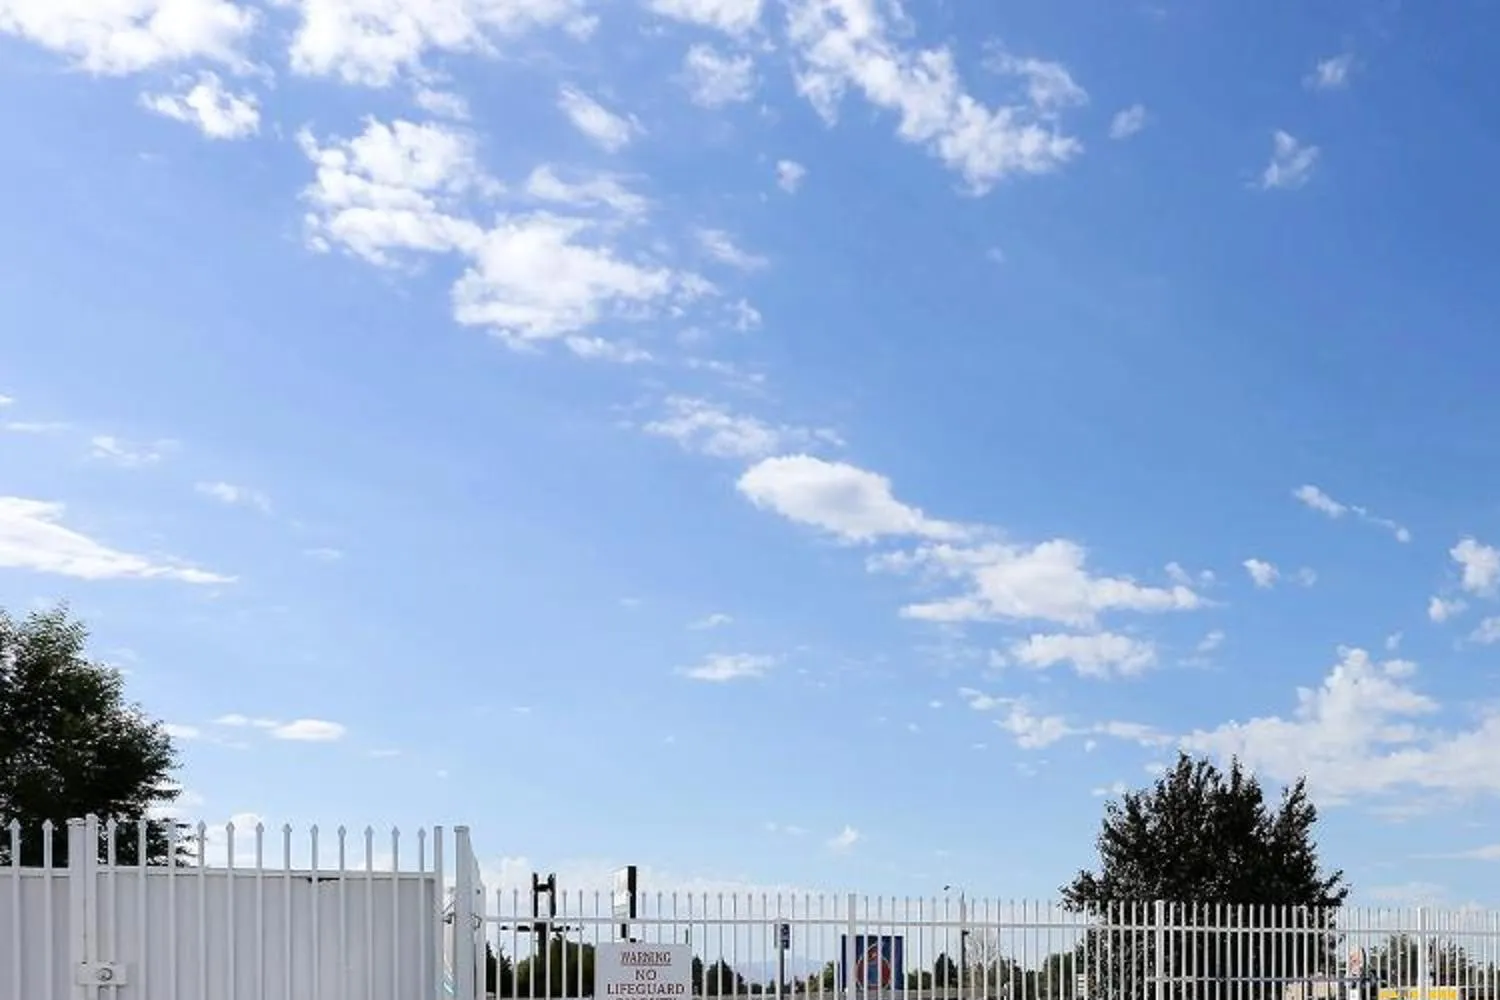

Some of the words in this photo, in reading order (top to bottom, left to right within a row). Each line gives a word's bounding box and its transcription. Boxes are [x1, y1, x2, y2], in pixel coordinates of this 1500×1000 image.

[621, 951, 671, 964] WARNING
[635, 969, 657, 980] NO
[607, 983, 685, 995] LIFEGUARD
